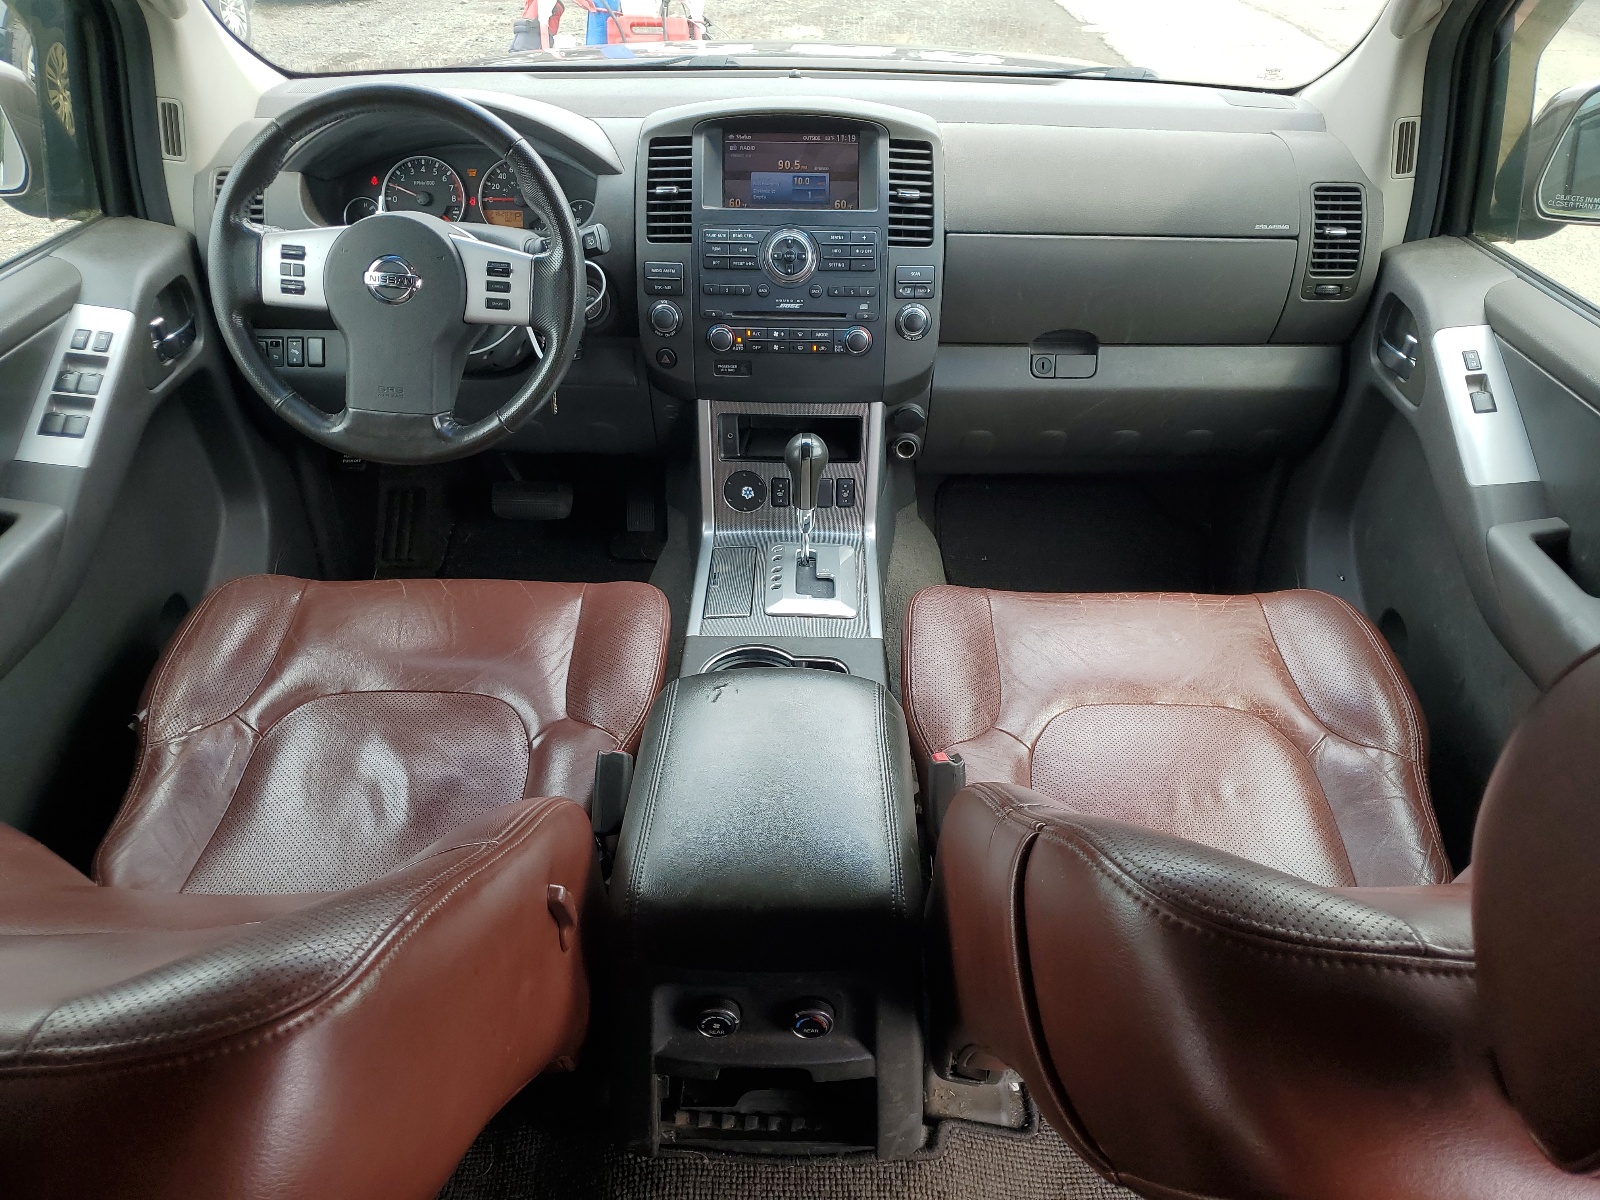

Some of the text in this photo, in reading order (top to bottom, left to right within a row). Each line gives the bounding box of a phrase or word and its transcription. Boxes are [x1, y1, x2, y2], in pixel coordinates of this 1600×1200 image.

[777, 160, 800, 170] 90.5
[400, 174, 406, 182] 2
[793, 177, 810, 185] 10.0
[449, 184, 455, 192] 7
[392, 195, 398, 203] 0
[451, 195, 457, 203] 8
[729, 198, 741, 208] 60
[834, 199, 847, 209] 60
[1547, 200, 1574, 208] CLOSER
[1575, 202, 1594, 210] THAN
[369, 274, 414, 287] NISSAN
